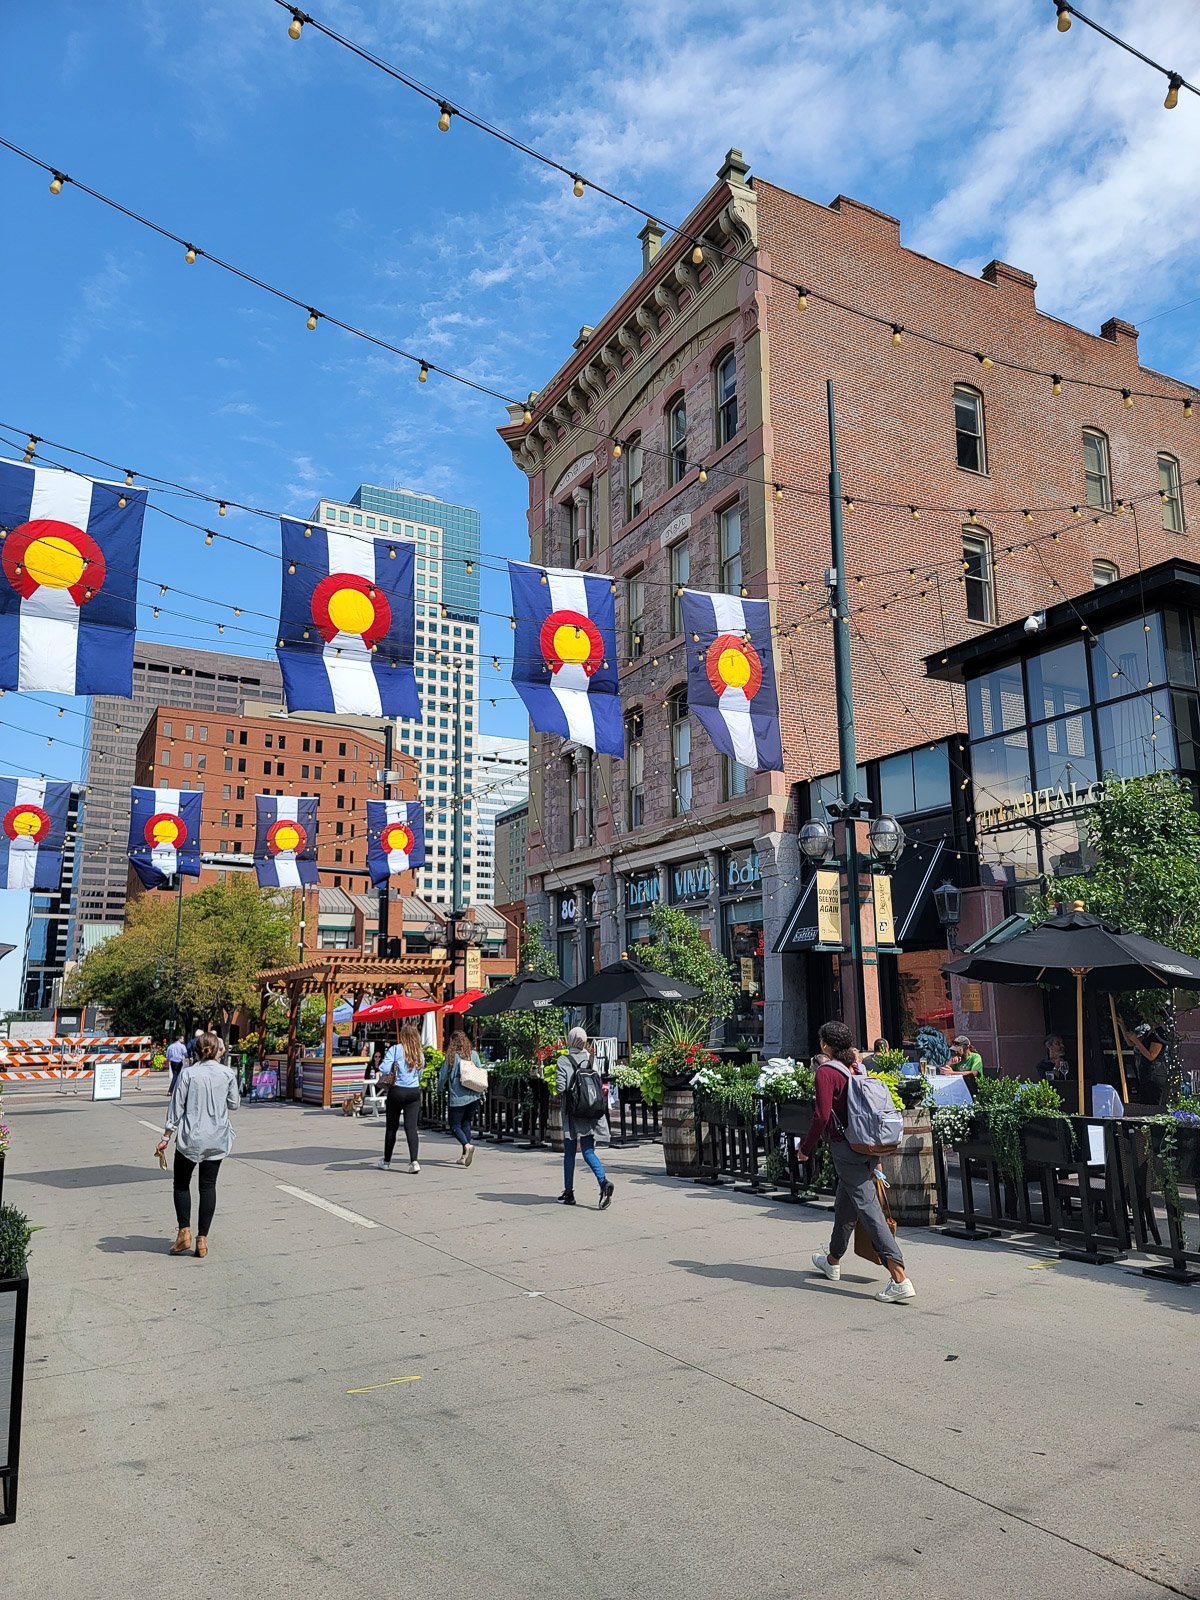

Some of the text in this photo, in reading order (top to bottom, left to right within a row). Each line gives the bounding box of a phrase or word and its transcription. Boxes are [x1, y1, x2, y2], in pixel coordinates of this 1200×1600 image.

[999, 782, 1086, 822] CAPITAL
[818, 888, 832, 896] GOOD
[818, 895, 839, 904] SEE YOU
[819, 904, 839, 914] AGAIN
